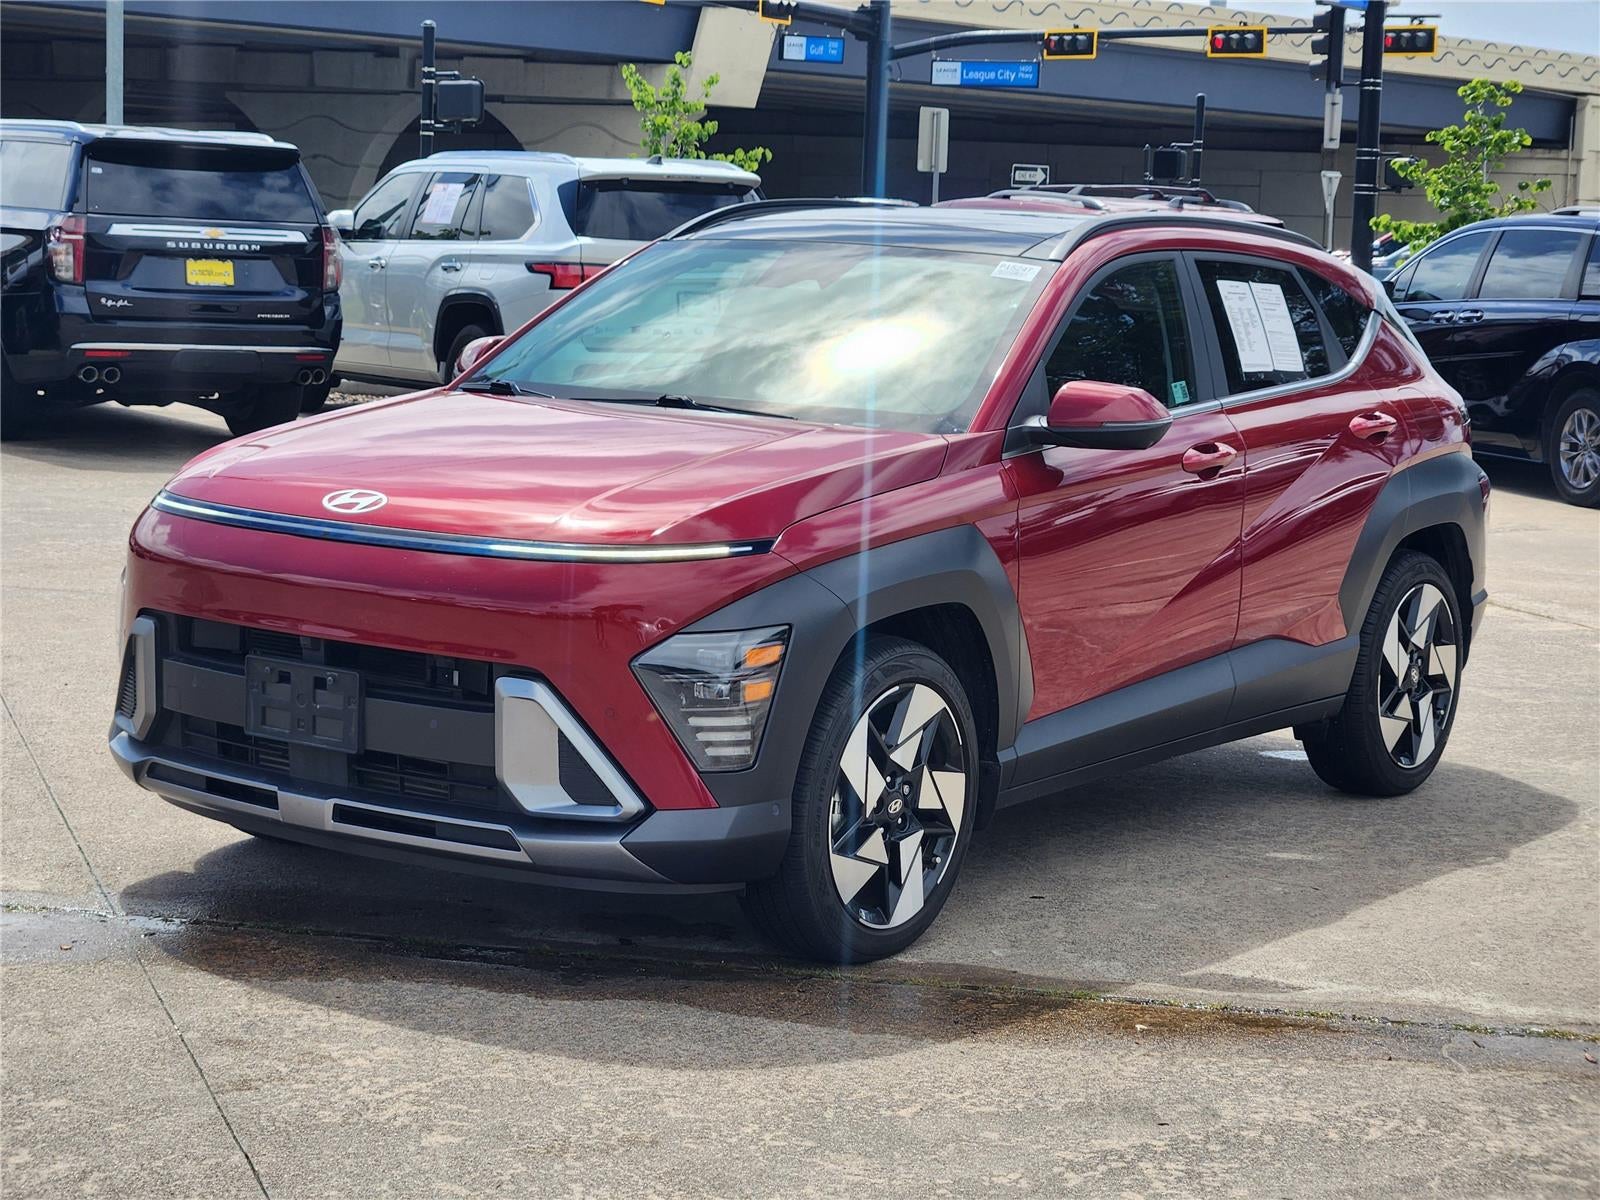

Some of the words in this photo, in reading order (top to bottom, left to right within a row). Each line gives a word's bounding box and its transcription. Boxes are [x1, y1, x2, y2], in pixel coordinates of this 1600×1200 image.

[809, 44, 824, 55] Gulf
[963, 69, 995, 82] League
[997, 68, 1016, 82] City
[166, 241, 260, 251] SUBURBAN
